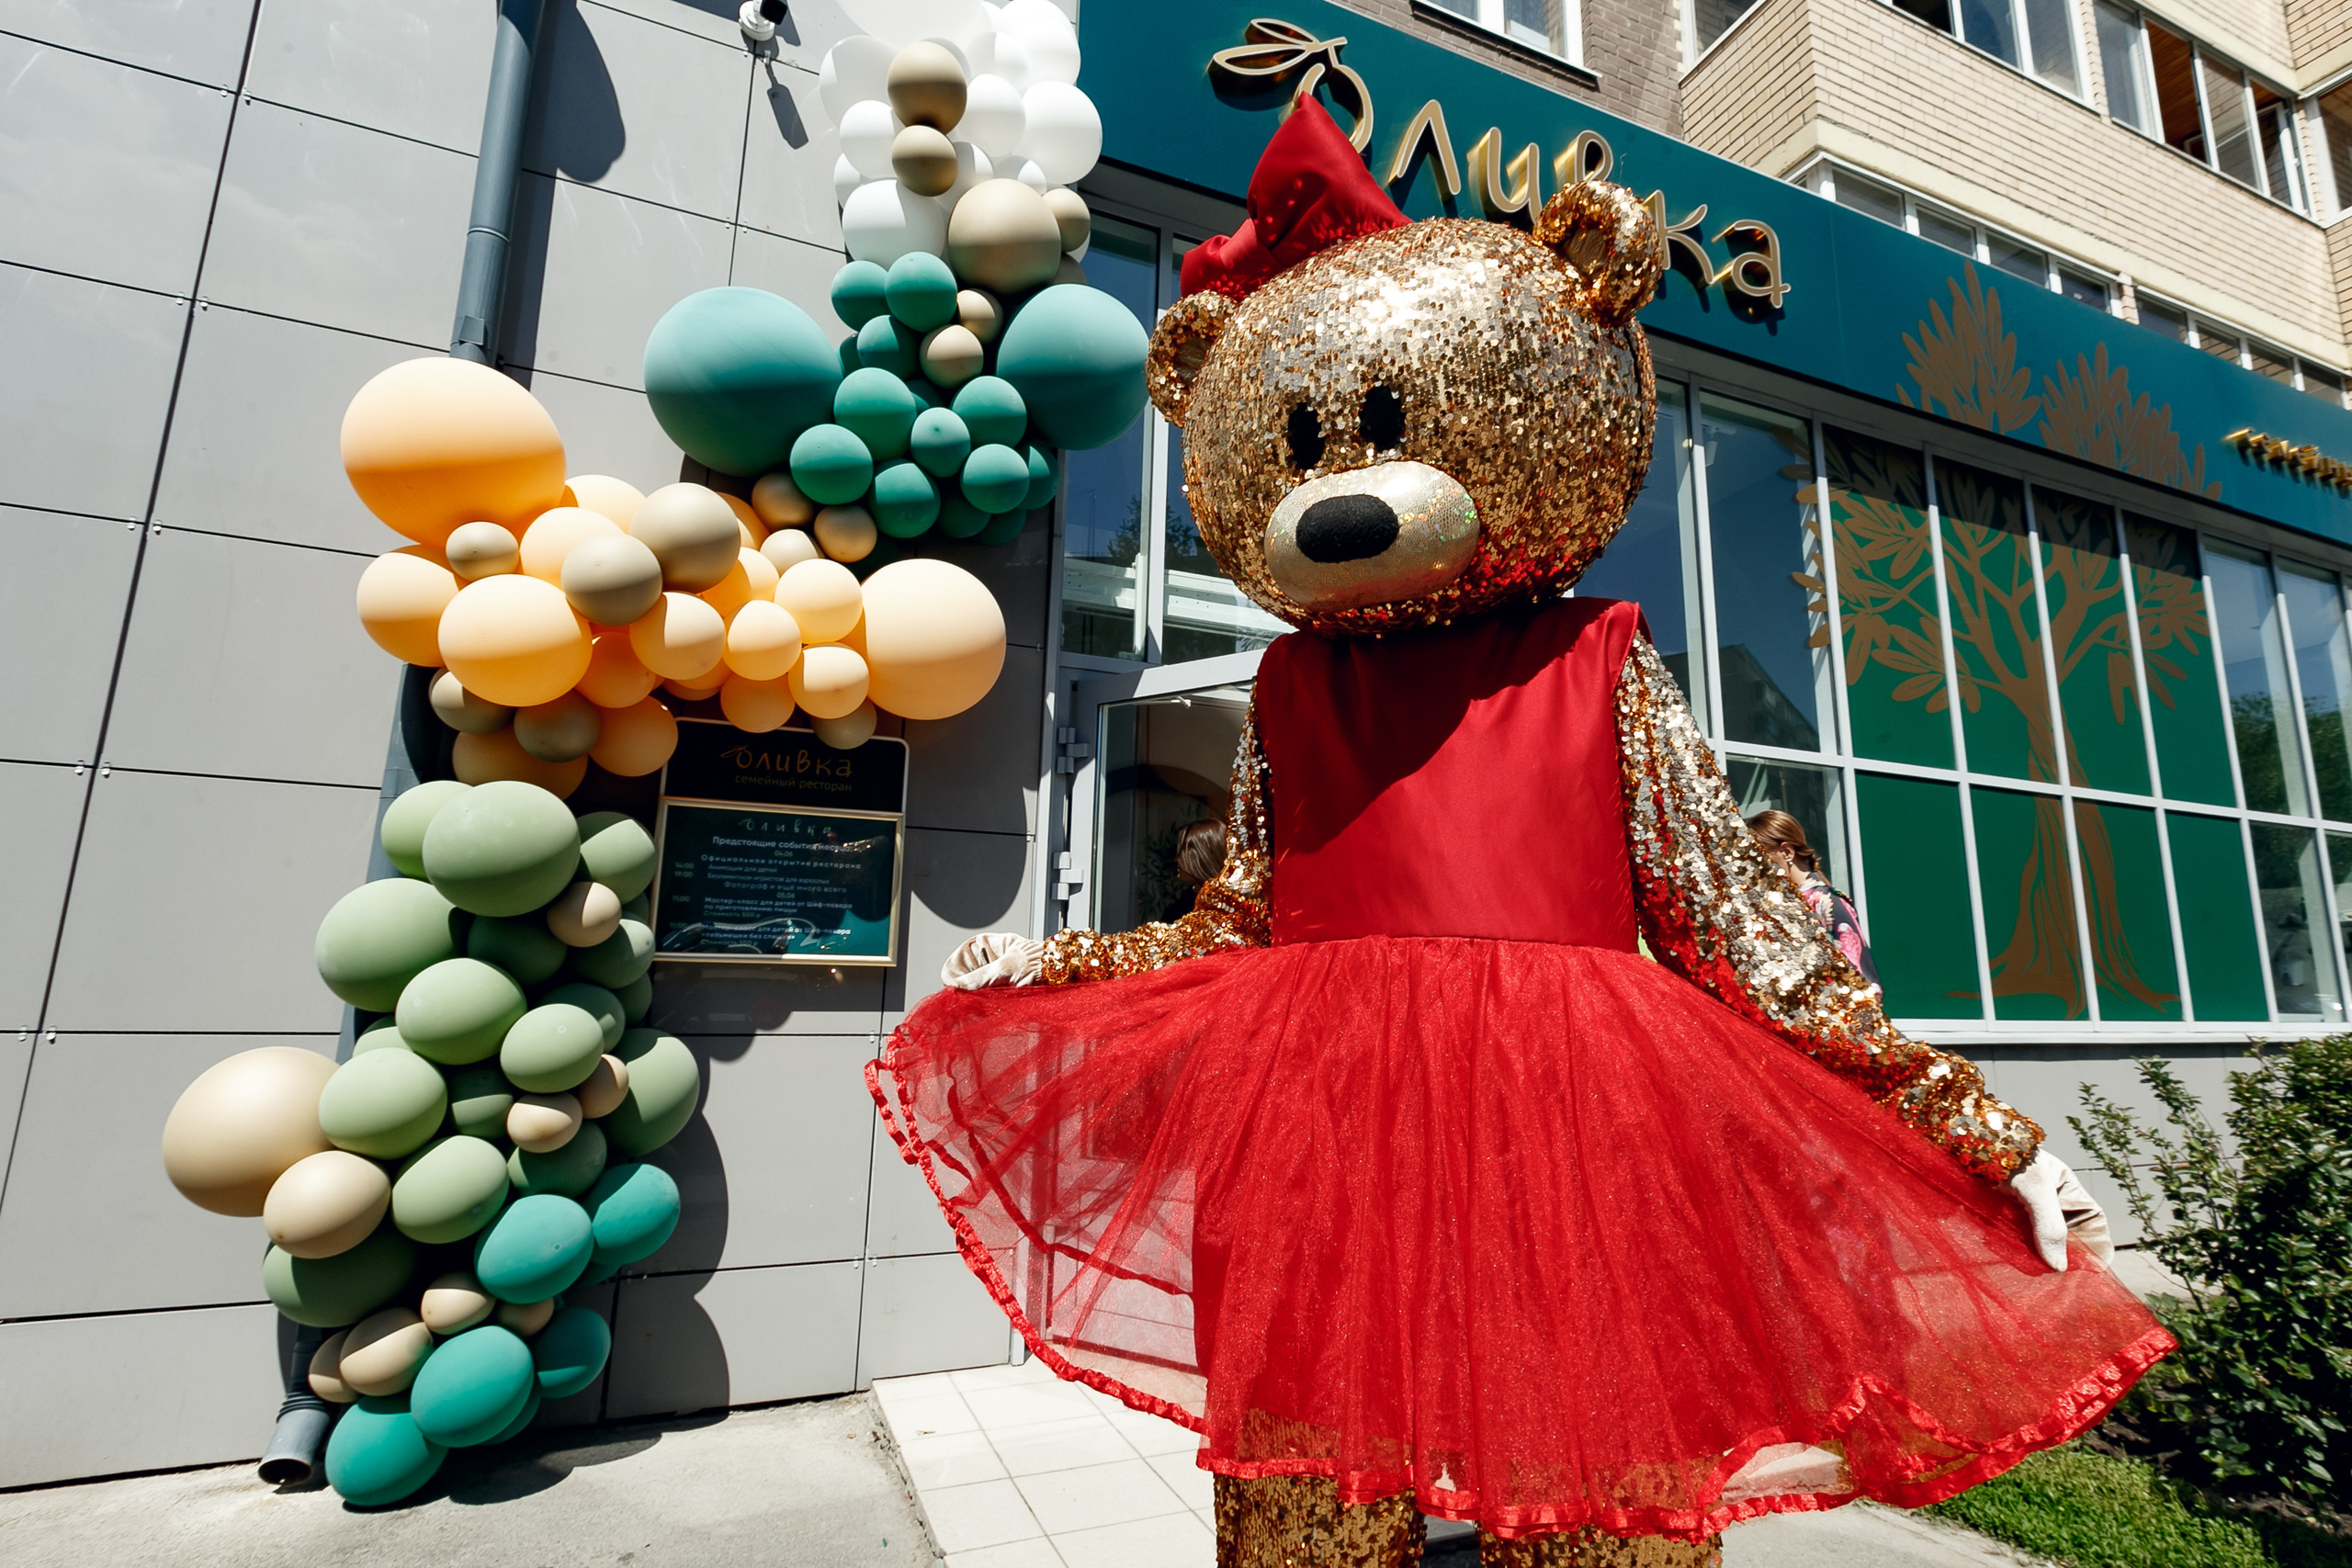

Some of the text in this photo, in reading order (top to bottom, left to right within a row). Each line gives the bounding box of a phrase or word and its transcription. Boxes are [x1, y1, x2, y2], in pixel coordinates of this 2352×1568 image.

[735, 773, 853, 794] семейный ресторан
[712, 836, 776, 848] Предстоящие
[778, 841, 818, 851] события
[700, 854, 862, 870] Официальное открытие ресторана
[723, 881, 768, 890] Фотограф
